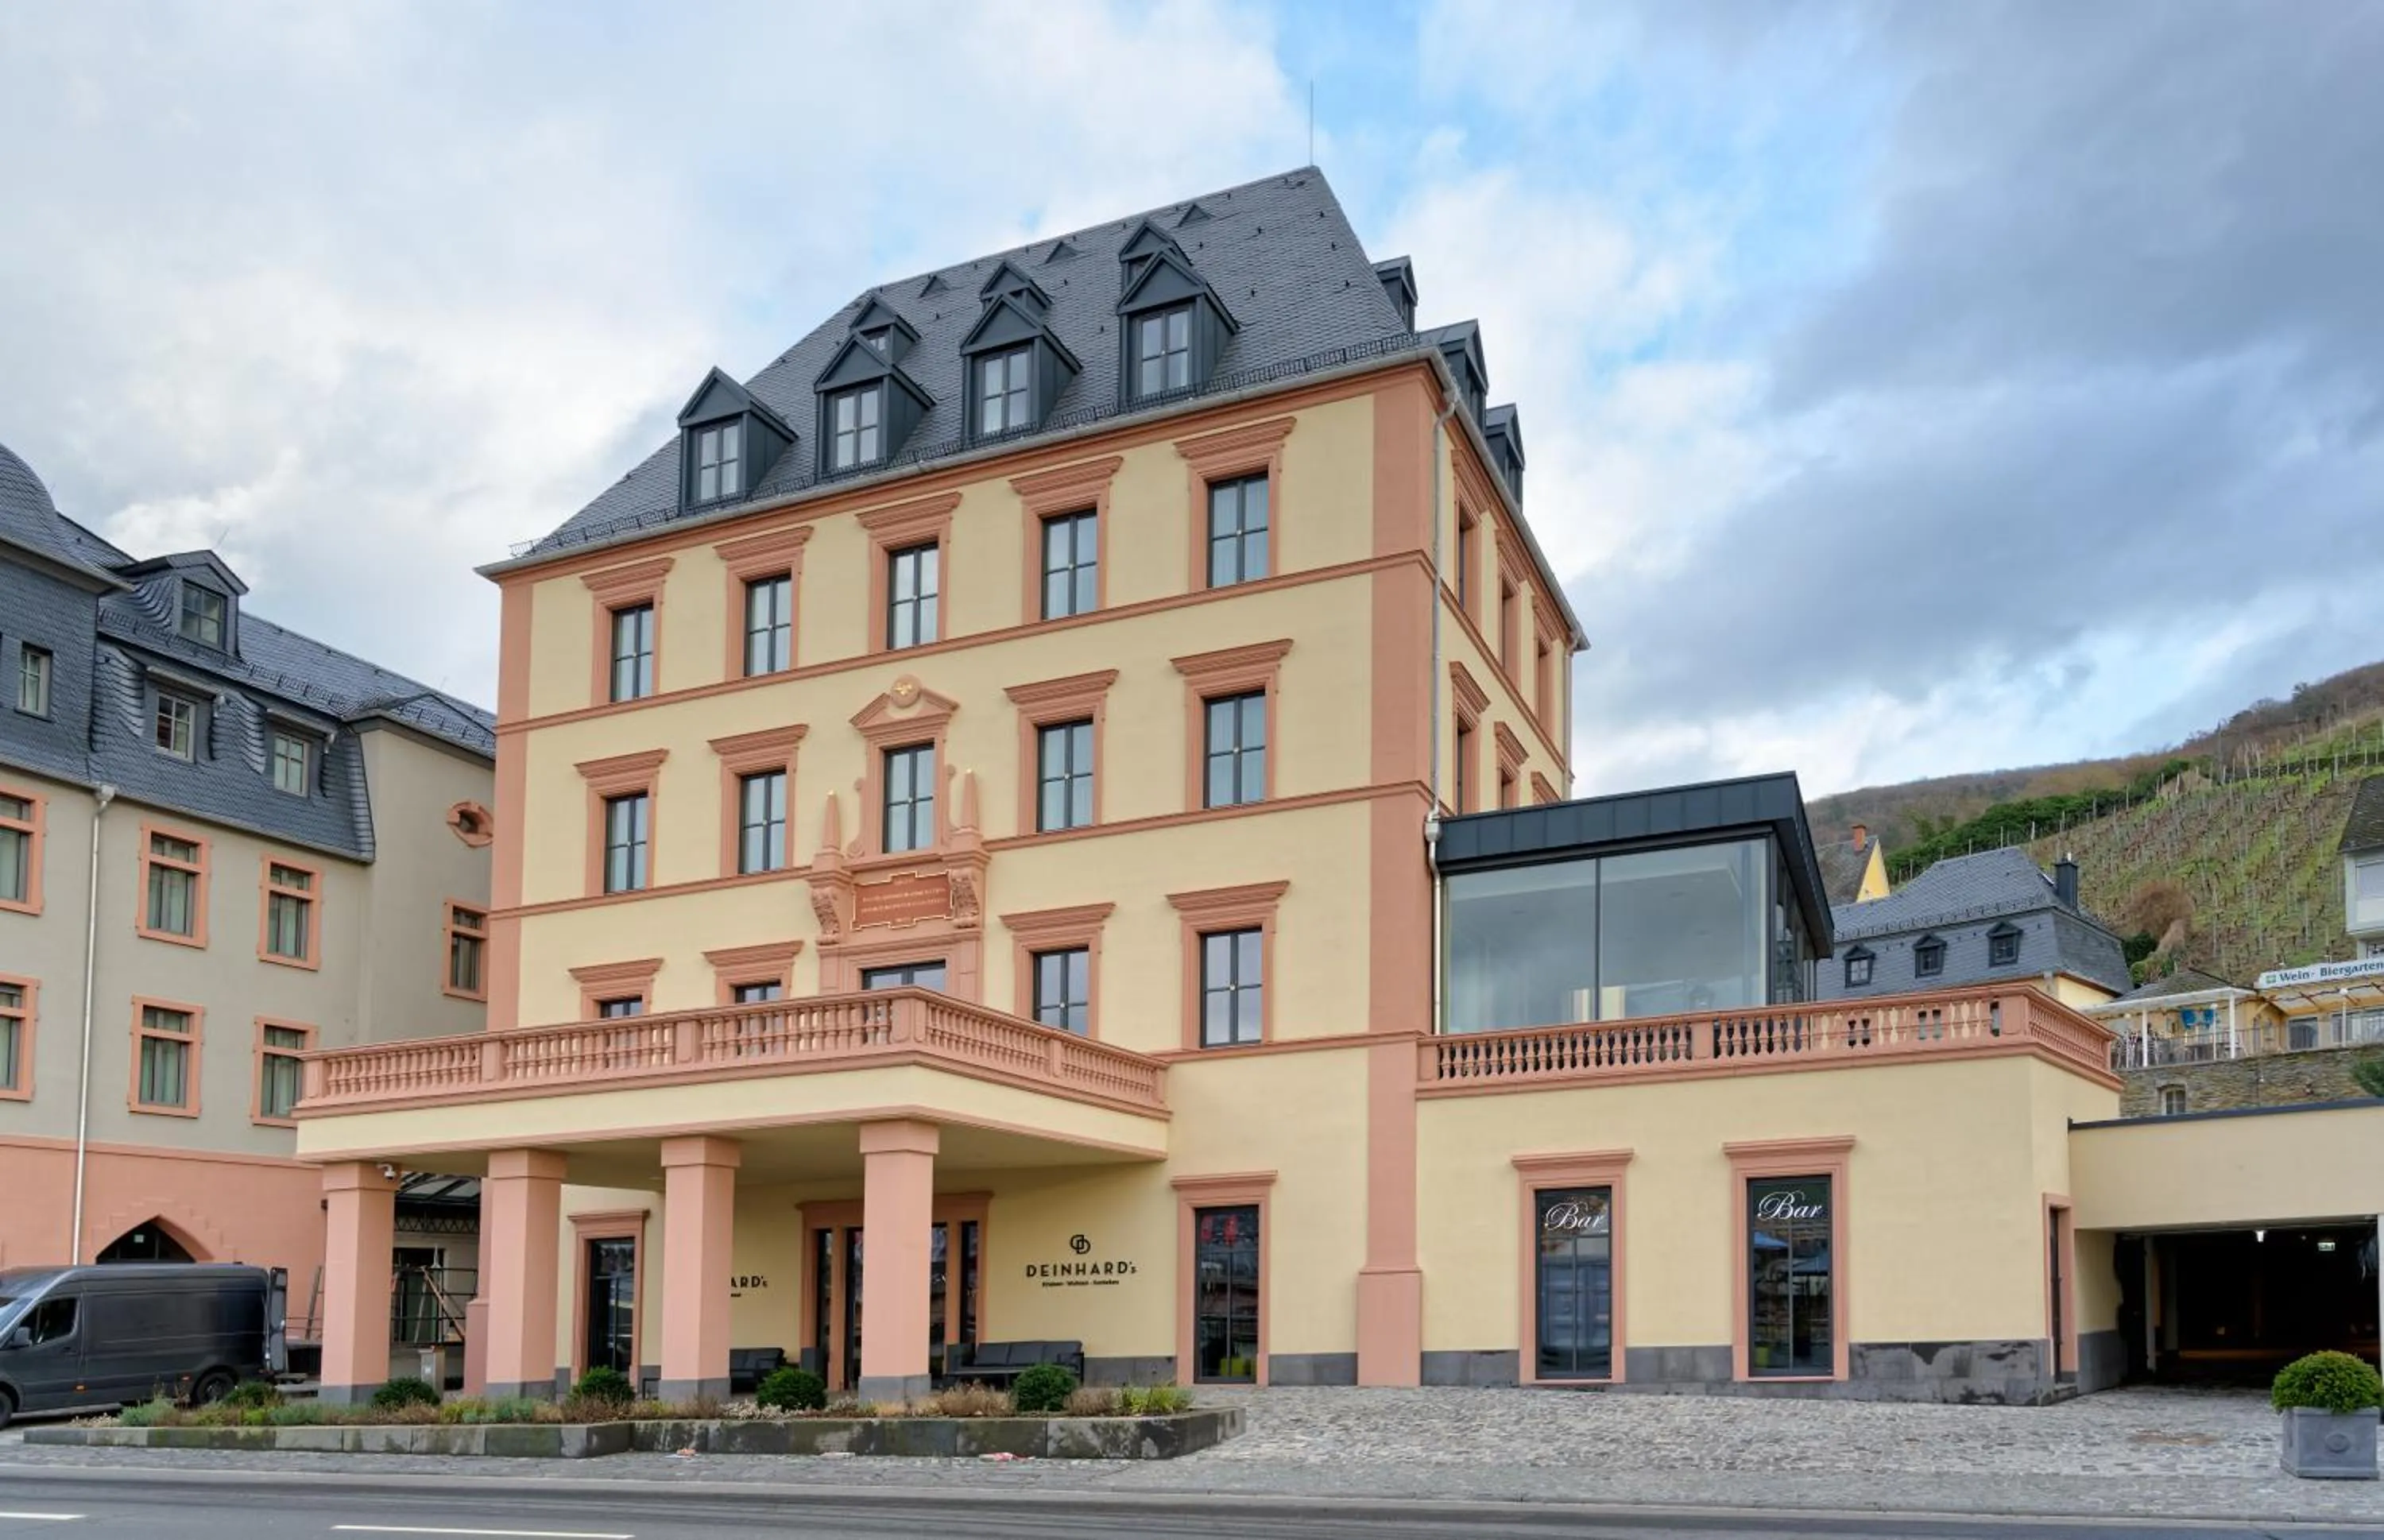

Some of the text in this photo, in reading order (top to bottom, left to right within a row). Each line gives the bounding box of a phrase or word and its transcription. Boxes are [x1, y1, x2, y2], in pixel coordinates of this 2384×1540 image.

[2320, 962, 2384, 977] Biergarten
[1757, 1190, 1822, 1221] Bar
[1544, 1201, 1605, 1230] Bar
[1025, 1261, 1137, 1278] DEINHARD's
[730, 1275, 768, 1288] ARD's
